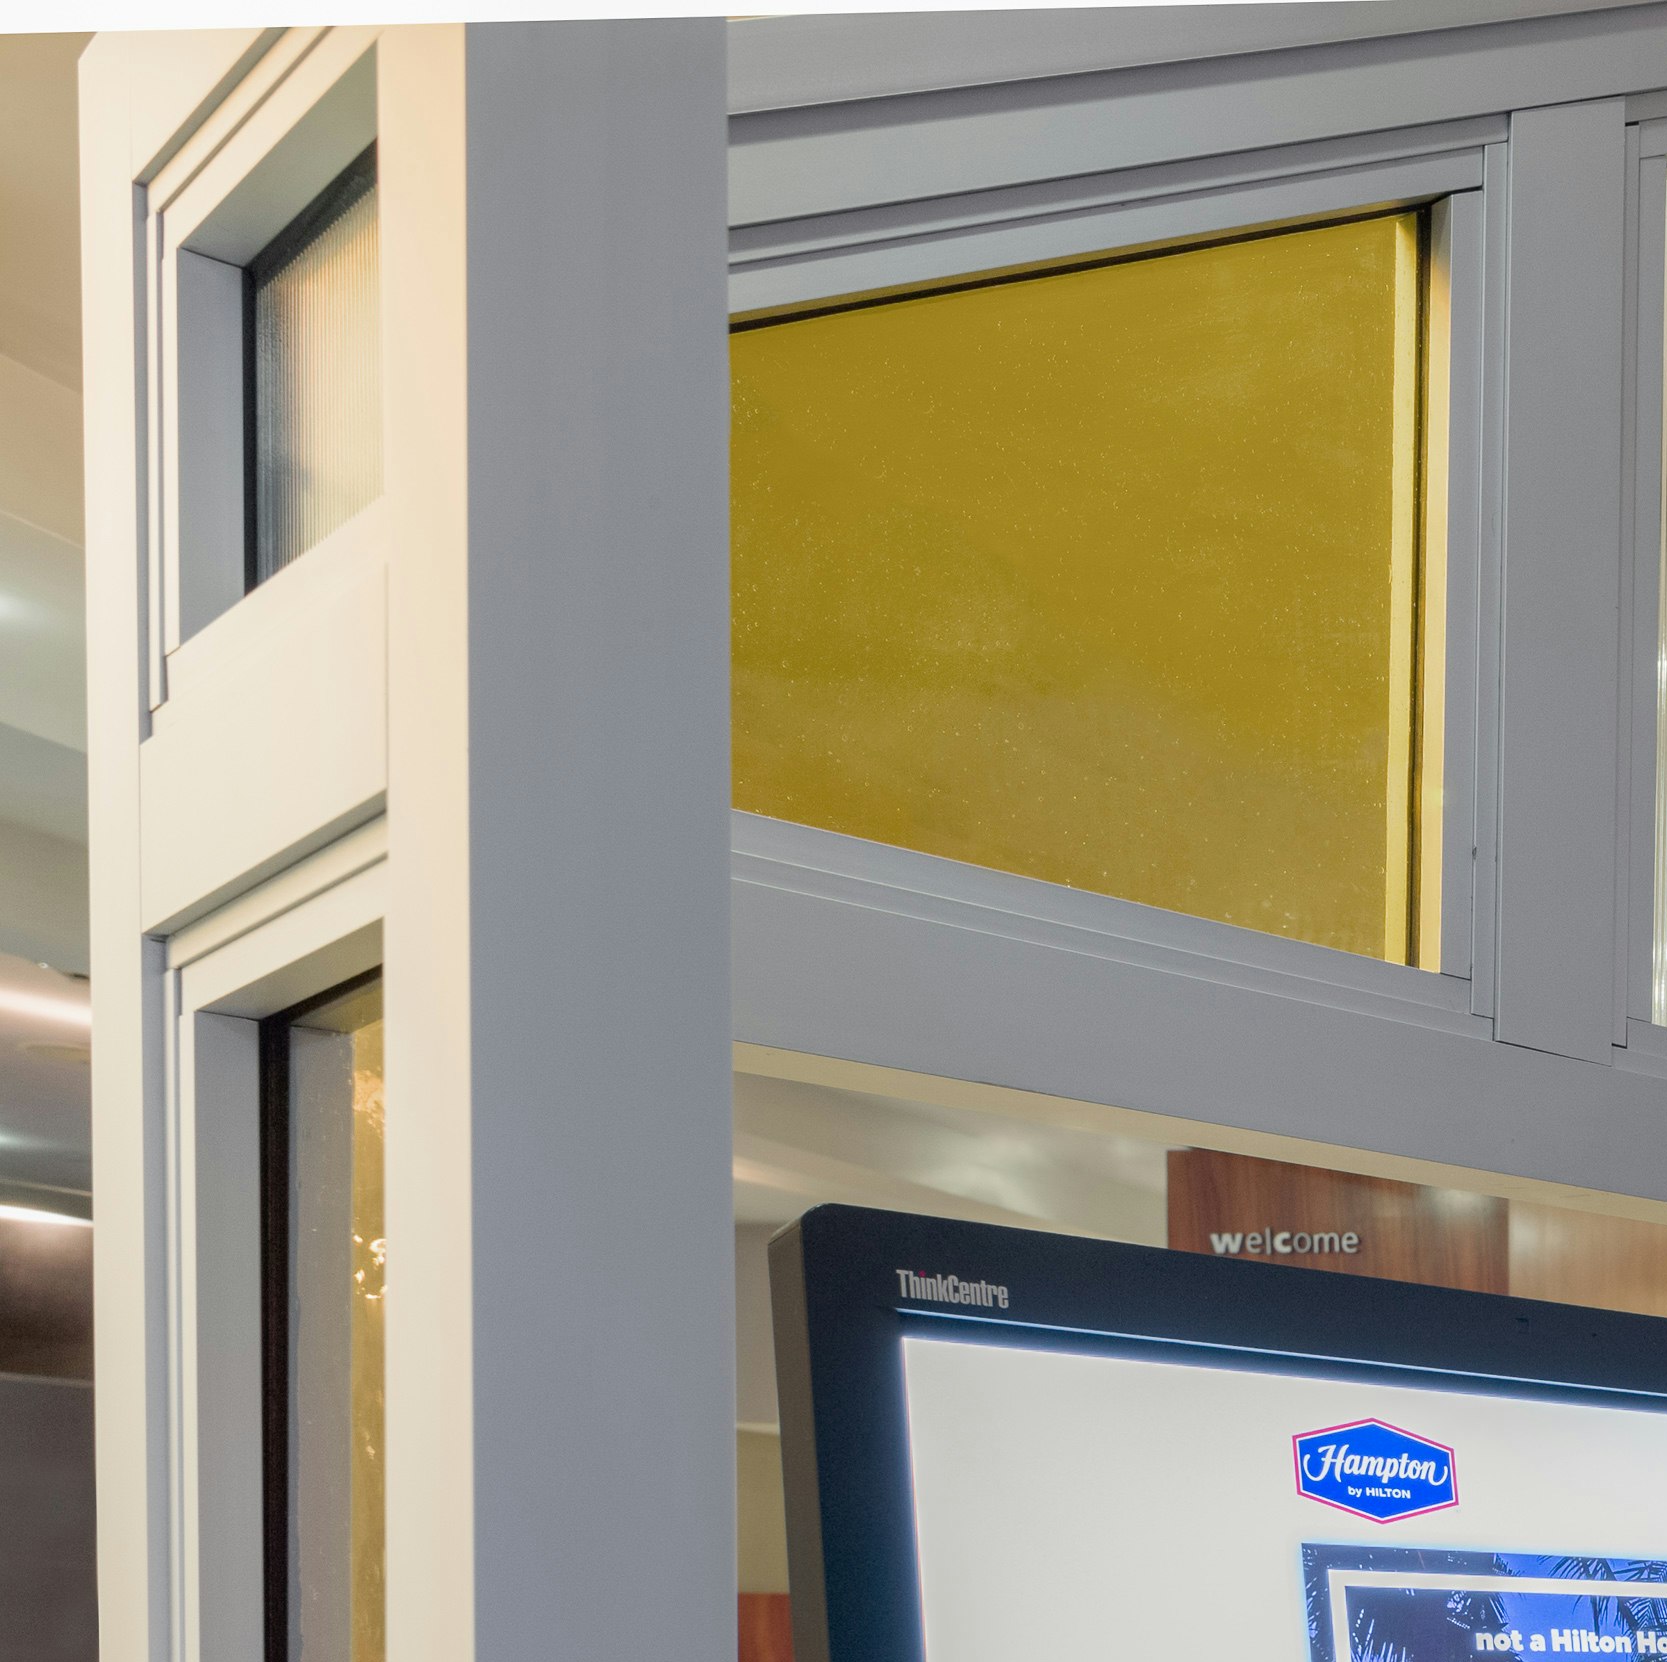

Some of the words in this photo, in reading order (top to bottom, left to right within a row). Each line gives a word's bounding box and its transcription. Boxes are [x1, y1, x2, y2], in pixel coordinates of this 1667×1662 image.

[1210, 1228, 1359, 1256] welcome
[896, 1269, 1009, 1309] ThinkCentre
[1303, 1444, 1448, 1486] Hampton
[1347, 1486, 1363, 1498] by
[1365, 1486, 1412, 1499] HILTON
[1476, 1629, 1524, 1652] not
[1529, 1633, 1546, 1652] a
[1551, 1628, 1633, 1654] Hilton
